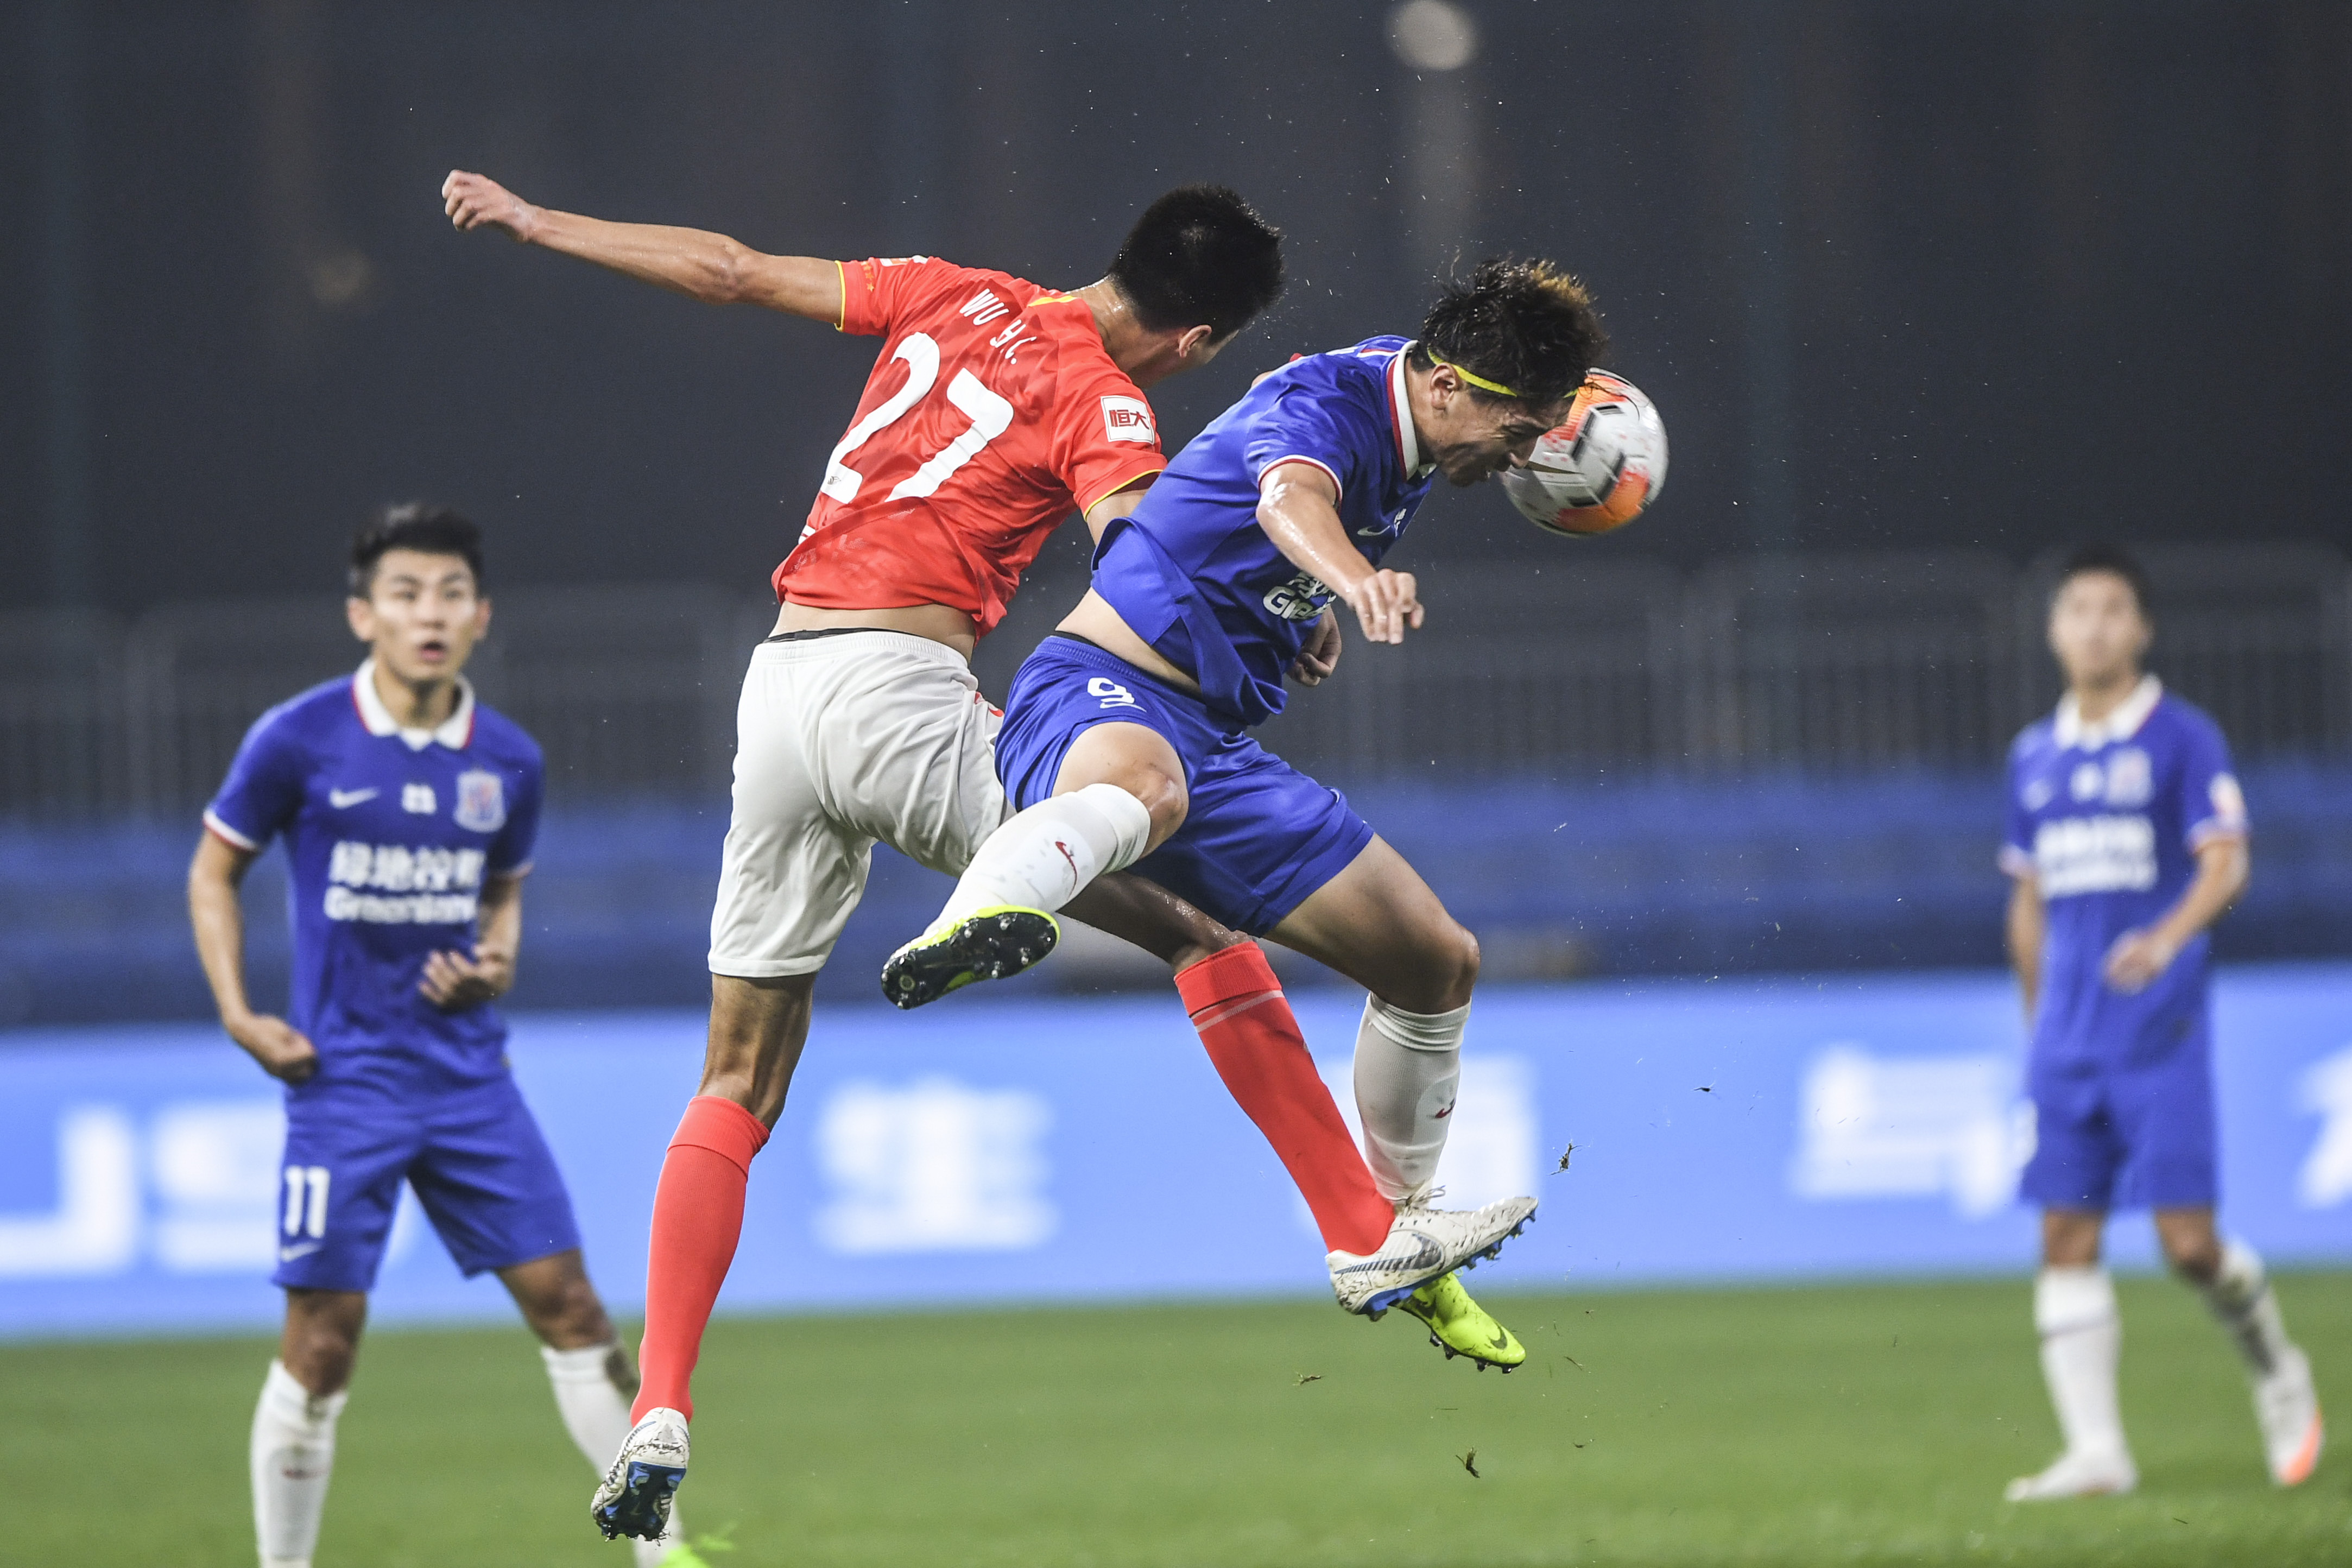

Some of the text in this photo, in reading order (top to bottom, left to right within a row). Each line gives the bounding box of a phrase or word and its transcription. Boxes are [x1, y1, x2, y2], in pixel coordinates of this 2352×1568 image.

[959, 288, 1009, 326] WU
[820, 332, 1014, 504] 27
[1109, 409, 1150, 430] 恒大
[1088, 677, 1135, 704] 9
[285, 1166, 330, 1238] 11
